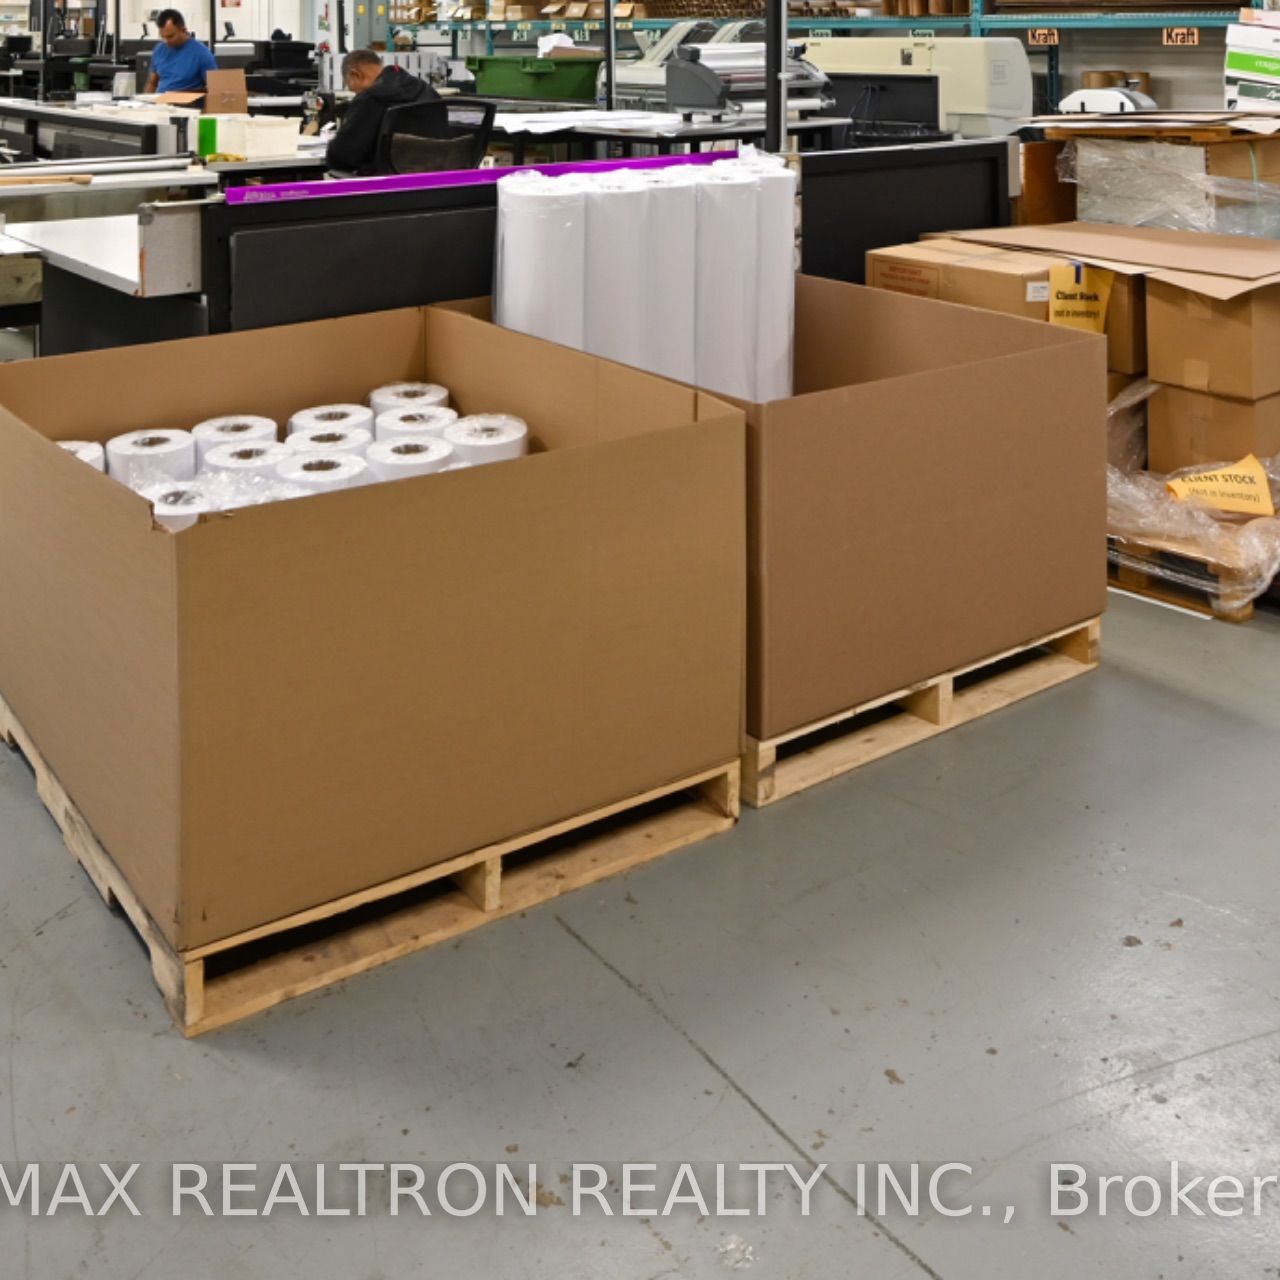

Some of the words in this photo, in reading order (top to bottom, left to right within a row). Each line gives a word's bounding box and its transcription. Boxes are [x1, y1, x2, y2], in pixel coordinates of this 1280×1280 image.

[1030, 28, 1056, 44] Kraft
[1166, 27, 1196, 44] Kraft
[1221, 473, 1257, 485] STOCK
